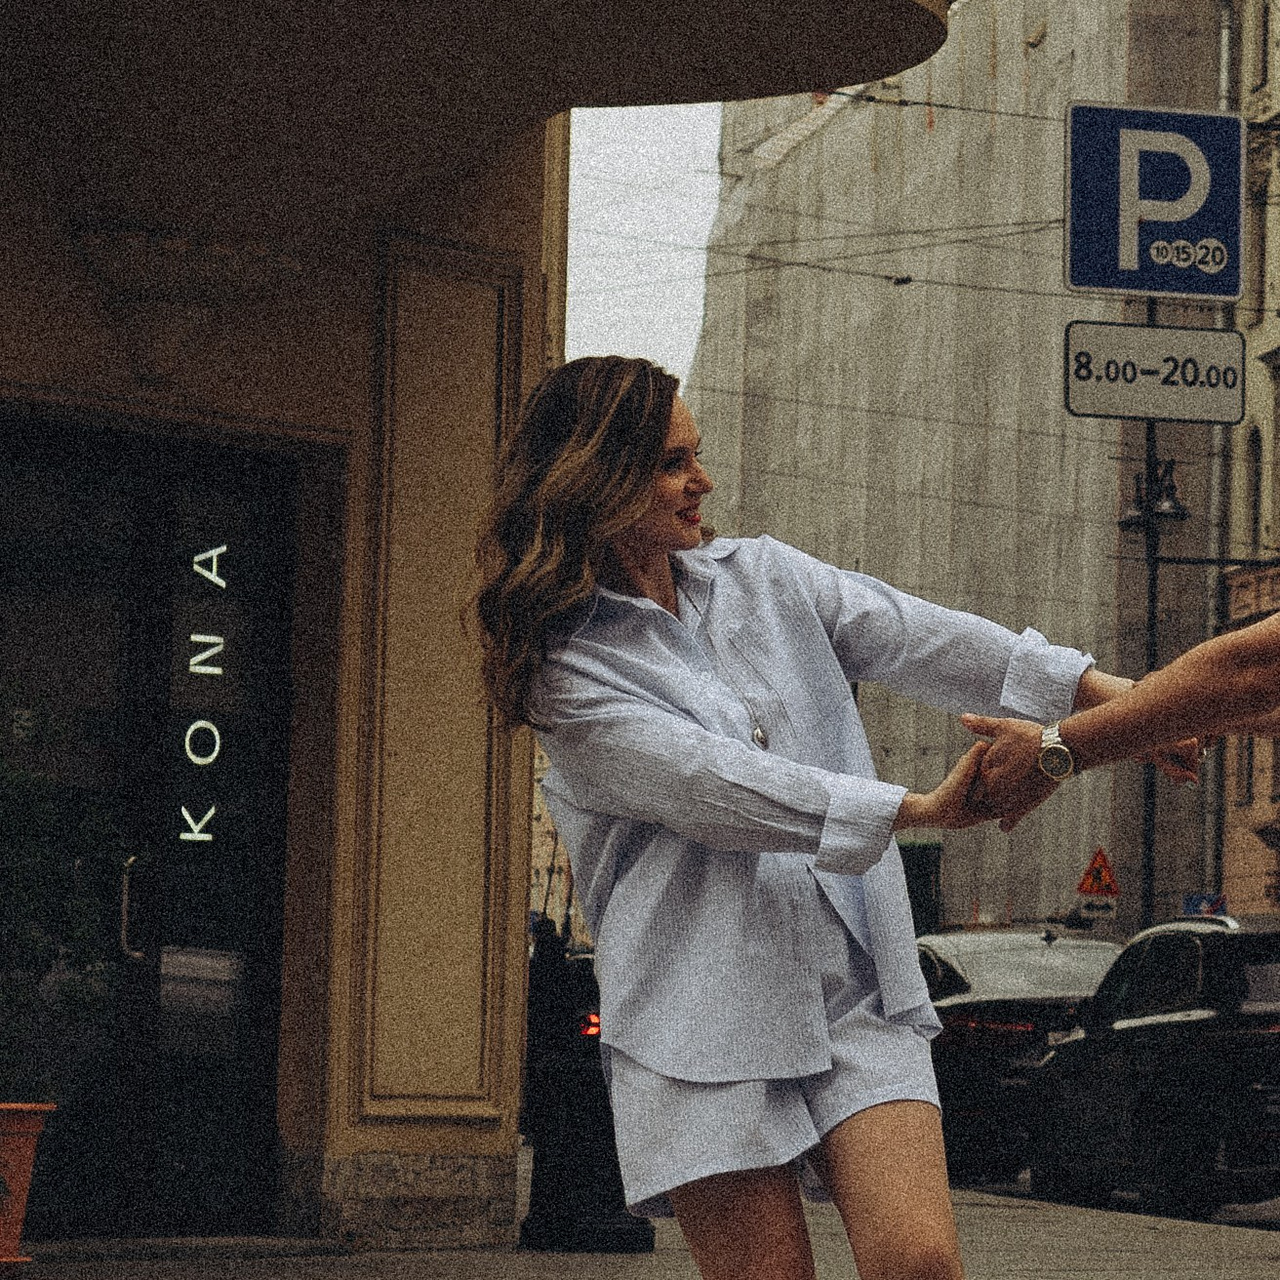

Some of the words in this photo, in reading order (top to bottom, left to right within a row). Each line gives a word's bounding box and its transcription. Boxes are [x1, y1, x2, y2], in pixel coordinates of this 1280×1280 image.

[1118, 127, 1211, 271] P
[1198, 244, 1225, 266] 20
[179, 544, 228, 842] KONA
